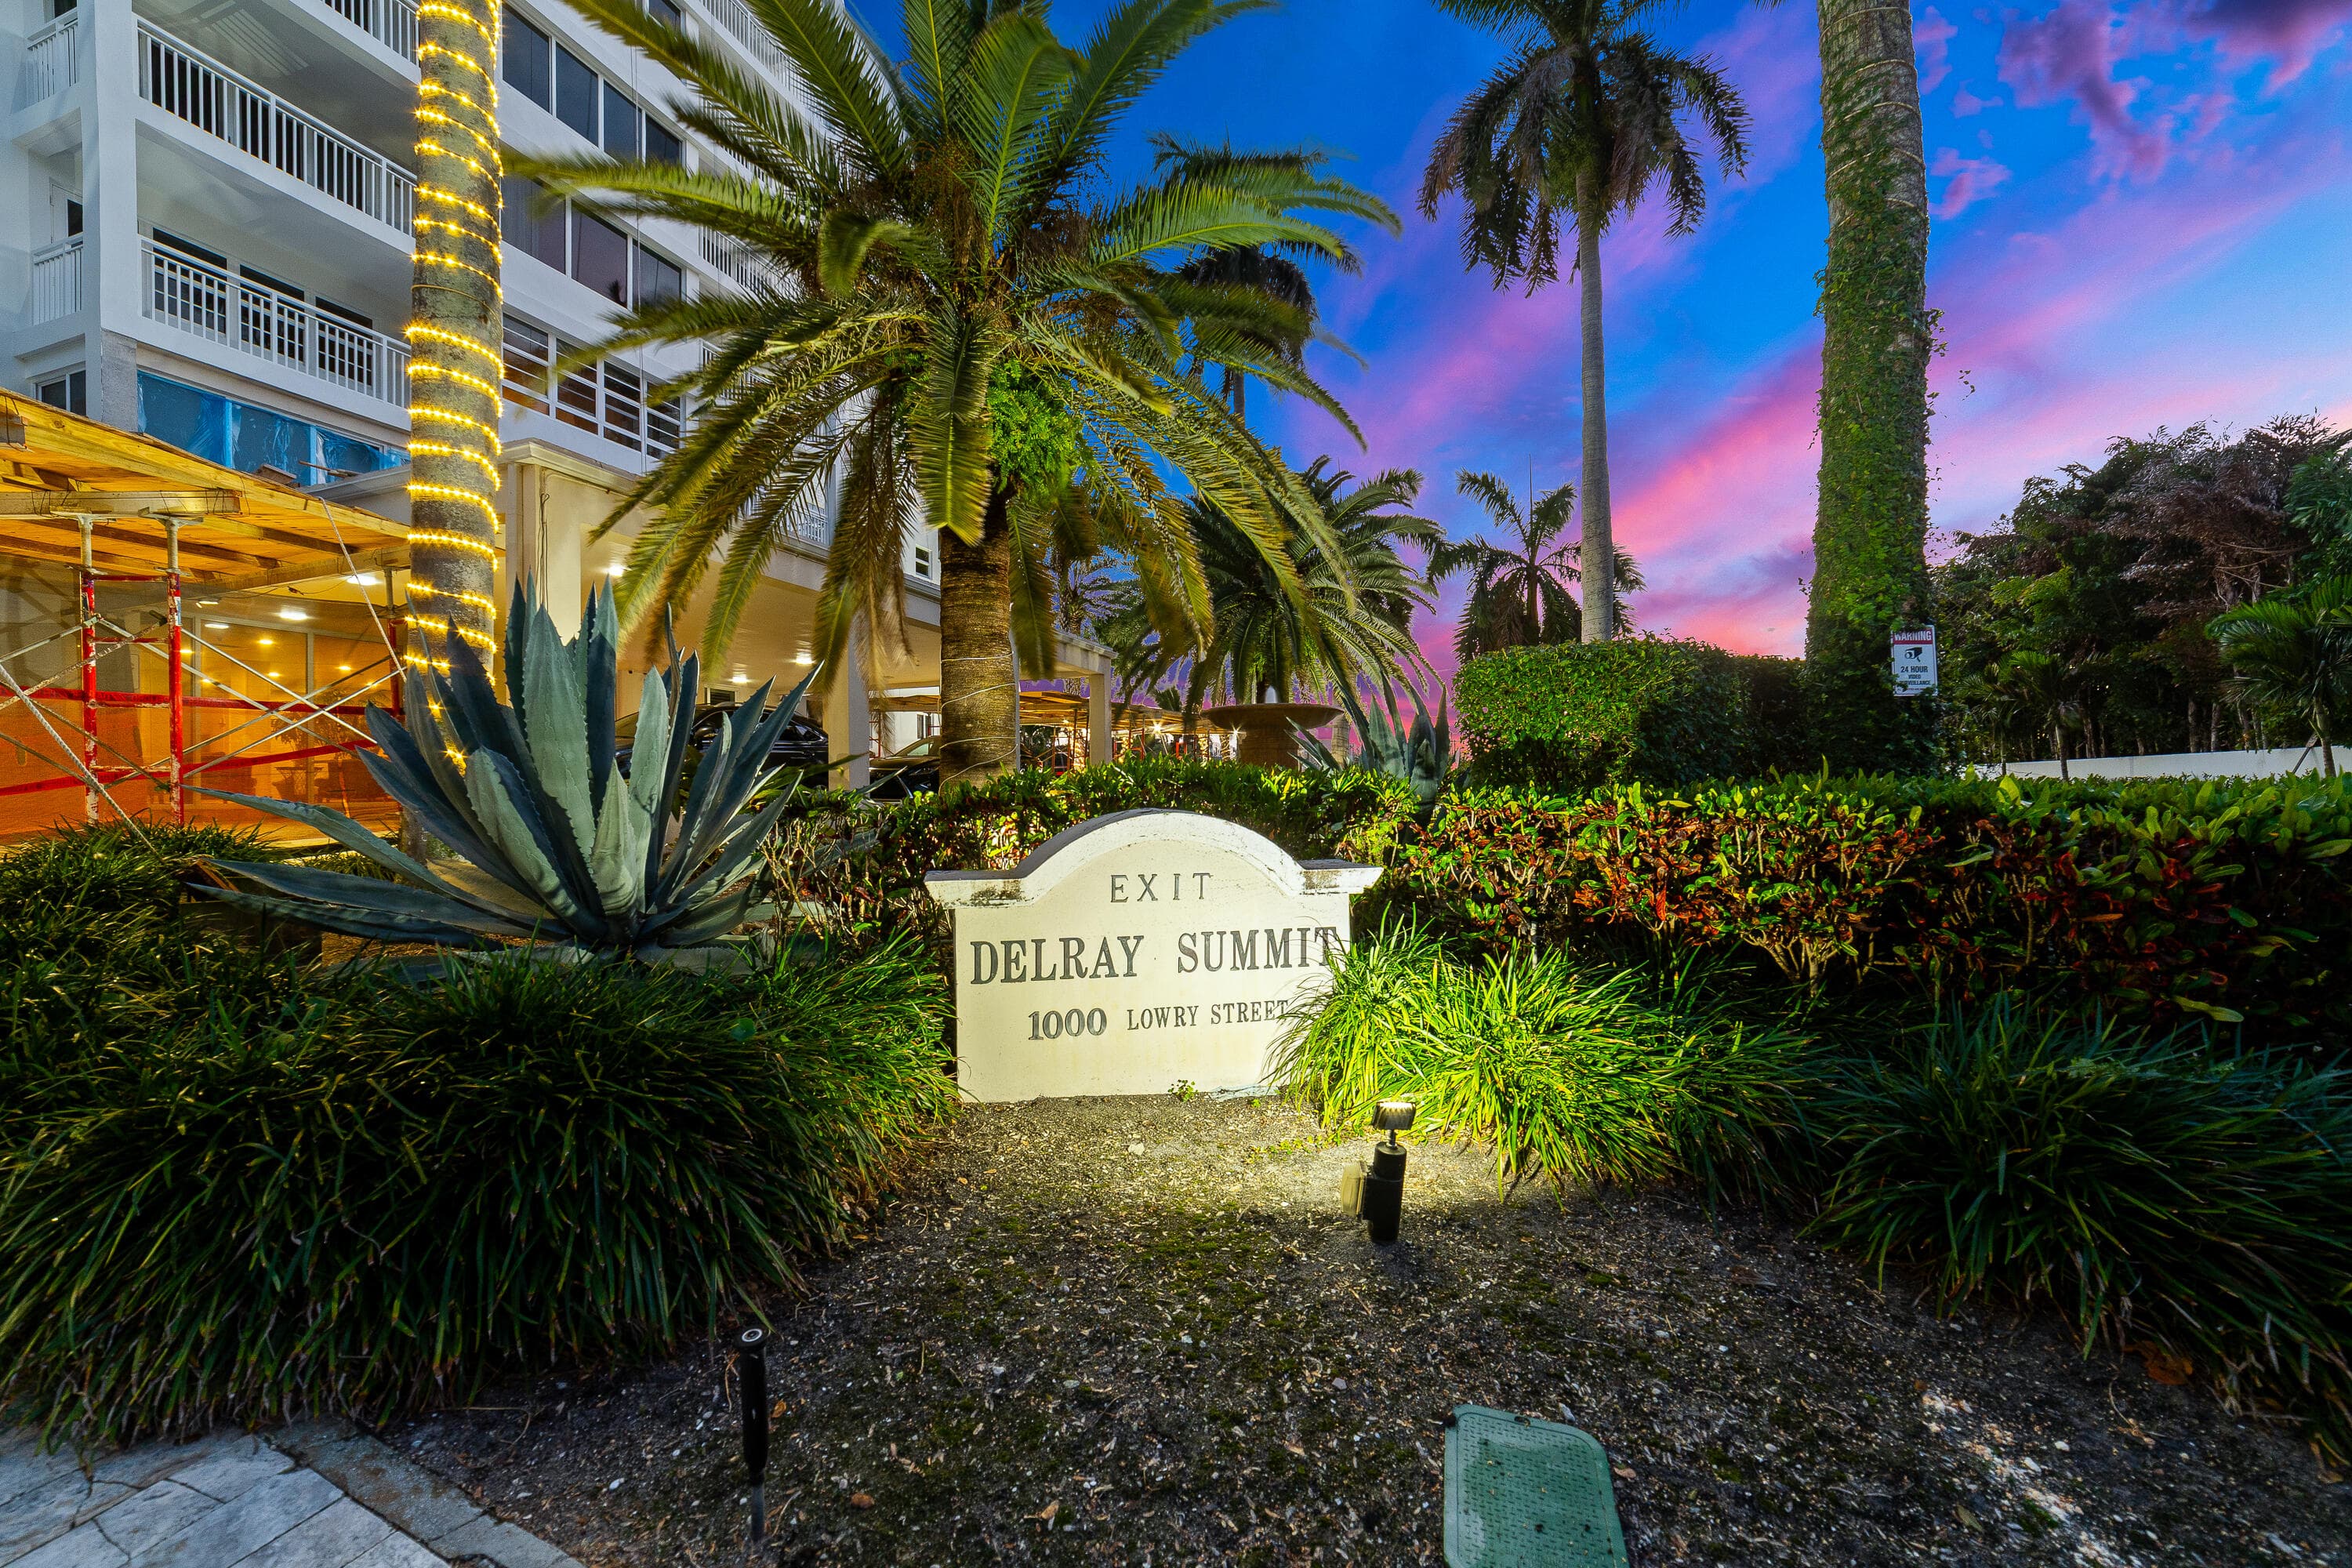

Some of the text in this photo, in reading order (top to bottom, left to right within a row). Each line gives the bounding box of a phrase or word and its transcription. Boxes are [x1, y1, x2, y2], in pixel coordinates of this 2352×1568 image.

[1894, 630, 1933, 641] WARNING
[1110, 873, 1211, 902] EXIT
[970, 926, 1338, 985] DELRAY SUMMIT
[1028, 1000, 1289, 1040] 1000 LOWRY STREET
